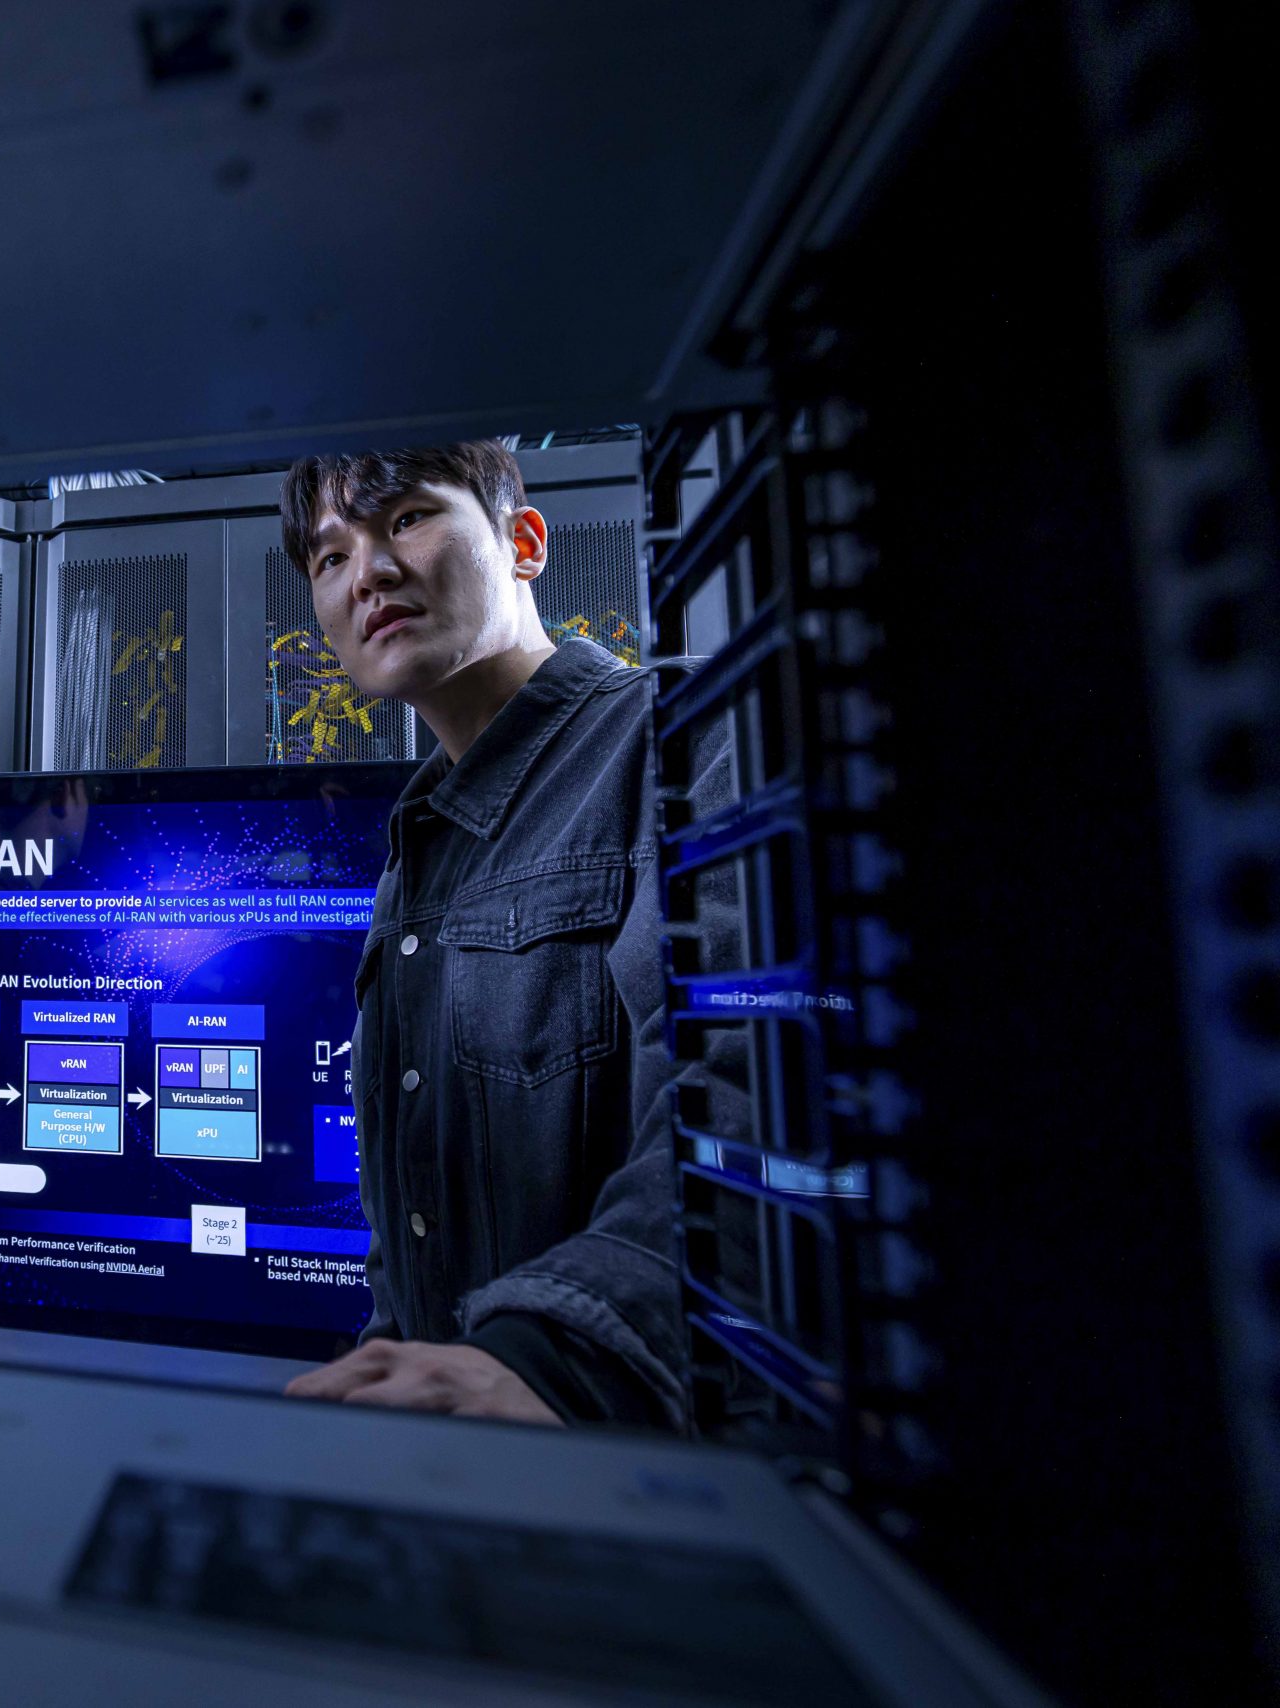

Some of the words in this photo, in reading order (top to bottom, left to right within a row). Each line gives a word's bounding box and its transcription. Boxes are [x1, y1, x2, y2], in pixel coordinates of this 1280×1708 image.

[40, 898, 78, 908] server
[79, 896, 93, 908] to
[96, 896, 141, 909] provide
[143, 895, 156, 907] AI
[159, 895, 210, 907] services
[212, 897, 226, 907] as
[228, 894, 256, 907] well
[258, 897, 273, 907] as
[275, 894, 297, 907] full
[299, 895, 327, 907] RAN
[19, 910, 97, 923] effectiveness
[99, 910, 112, 923] of
[113, 911, 156, 923] AI-RAN
[158, 910, 186, 923] with
[189, 910, 236, 923] various
[238, 911, 271, 923] xPUs
[273, 910, 298, 923] and
[302, 911, 373, 925] investigati
[24, 975, 90, 988] Evolution
[96, 975, 162, 990] Direction
[33, 1011, 90, 1023] Virtualized
[93, 1012, 116, 1024] RAN
[187, 1015, 227, 1027] AI-RAN
[60, 1058, 87, 1069] vRAN
[165, 1062, 194, 1073] vRAN
[204, 1063, 226, 1074] UPF
[236, 1064, 248, 1075] AI
[312, 1071, 329, 1083] UE
[40, 1088, 107, 1100] Virtualization
[171, 1092, 244, 1105] Virtualization
[53, 1108, 93, 1120] General
[40, 1120, 82, 1133] Purpose
[84, 1122, 106, 1134] H/W
[196, 1127, 218, 1138] xPU
[58, 1133, 87, 1146] (CPU)
[203, 1218, 229, 1230] Stage
[231, 1219, 238, 1229] 2
[12, 1237, 75, 1250] Performance
[78, 1242, 135, 1254] Verification
[30, 1256, 79, 1268] Verification
[80, 1260, 106, 1273] using
[106, 1262, 136, 1274] NVIDIA
[137, 1264, 165, 1277] Aerial
[267, 1255, 289, 1267] Full
[290, 1257, 321, 1270] Stack
[268, 1269, 300, 1281] based
[303, 1271, 334, 1284] vRAN
